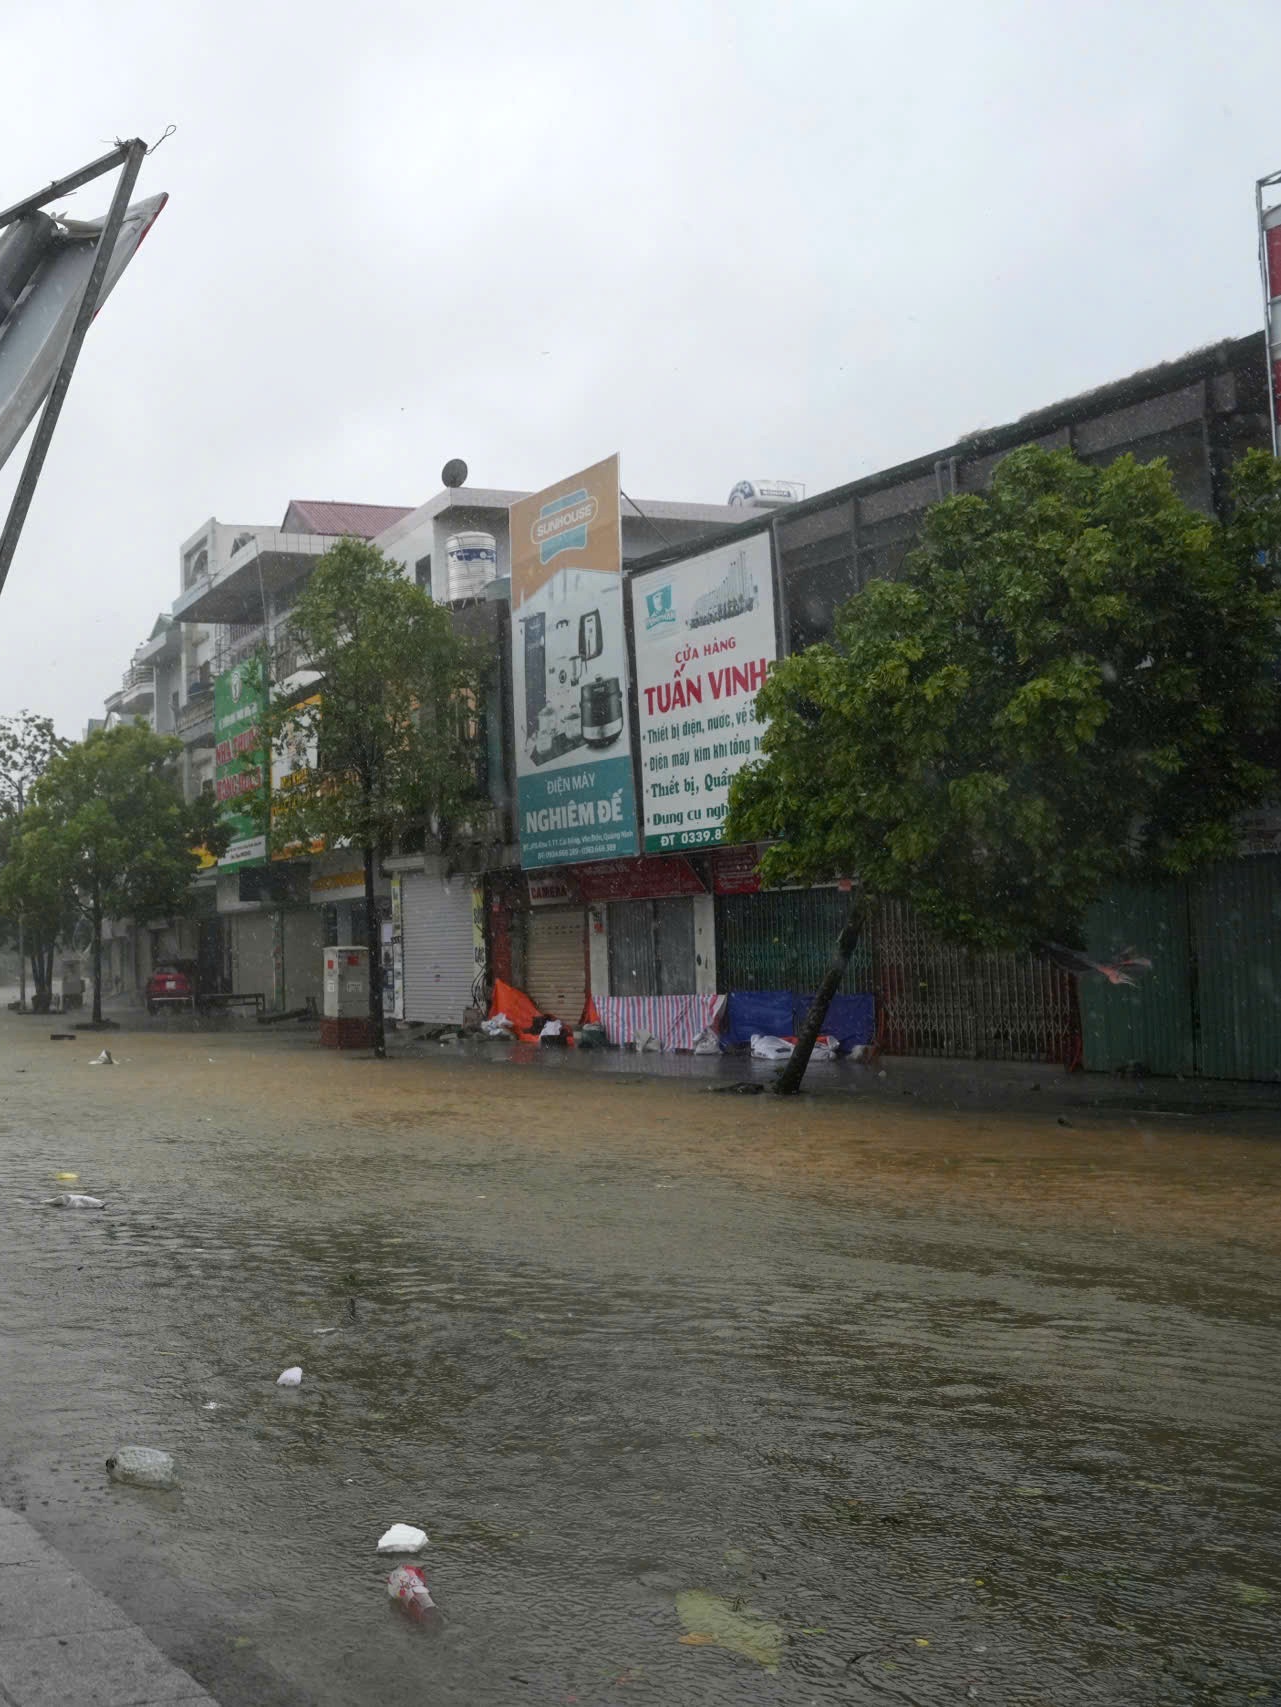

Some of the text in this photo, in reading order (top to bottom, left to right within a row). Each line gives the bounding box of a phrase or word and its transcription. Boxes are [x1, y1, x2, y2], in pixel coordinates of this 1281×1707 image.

[536, 503, 593, 537] SUNHOUSE
[675, 636, 737, 664] CỬA HÀNG
[643, 658, 767, 716] TUẤN VINH
[547, 771, 596, 796] ĐIỆN MÁY
[650, 776, 680, 798] Thiết
[526, 788, 624, 834] NGHIÊM ĐẾ
[660, 834, 676, 847] ĐT
